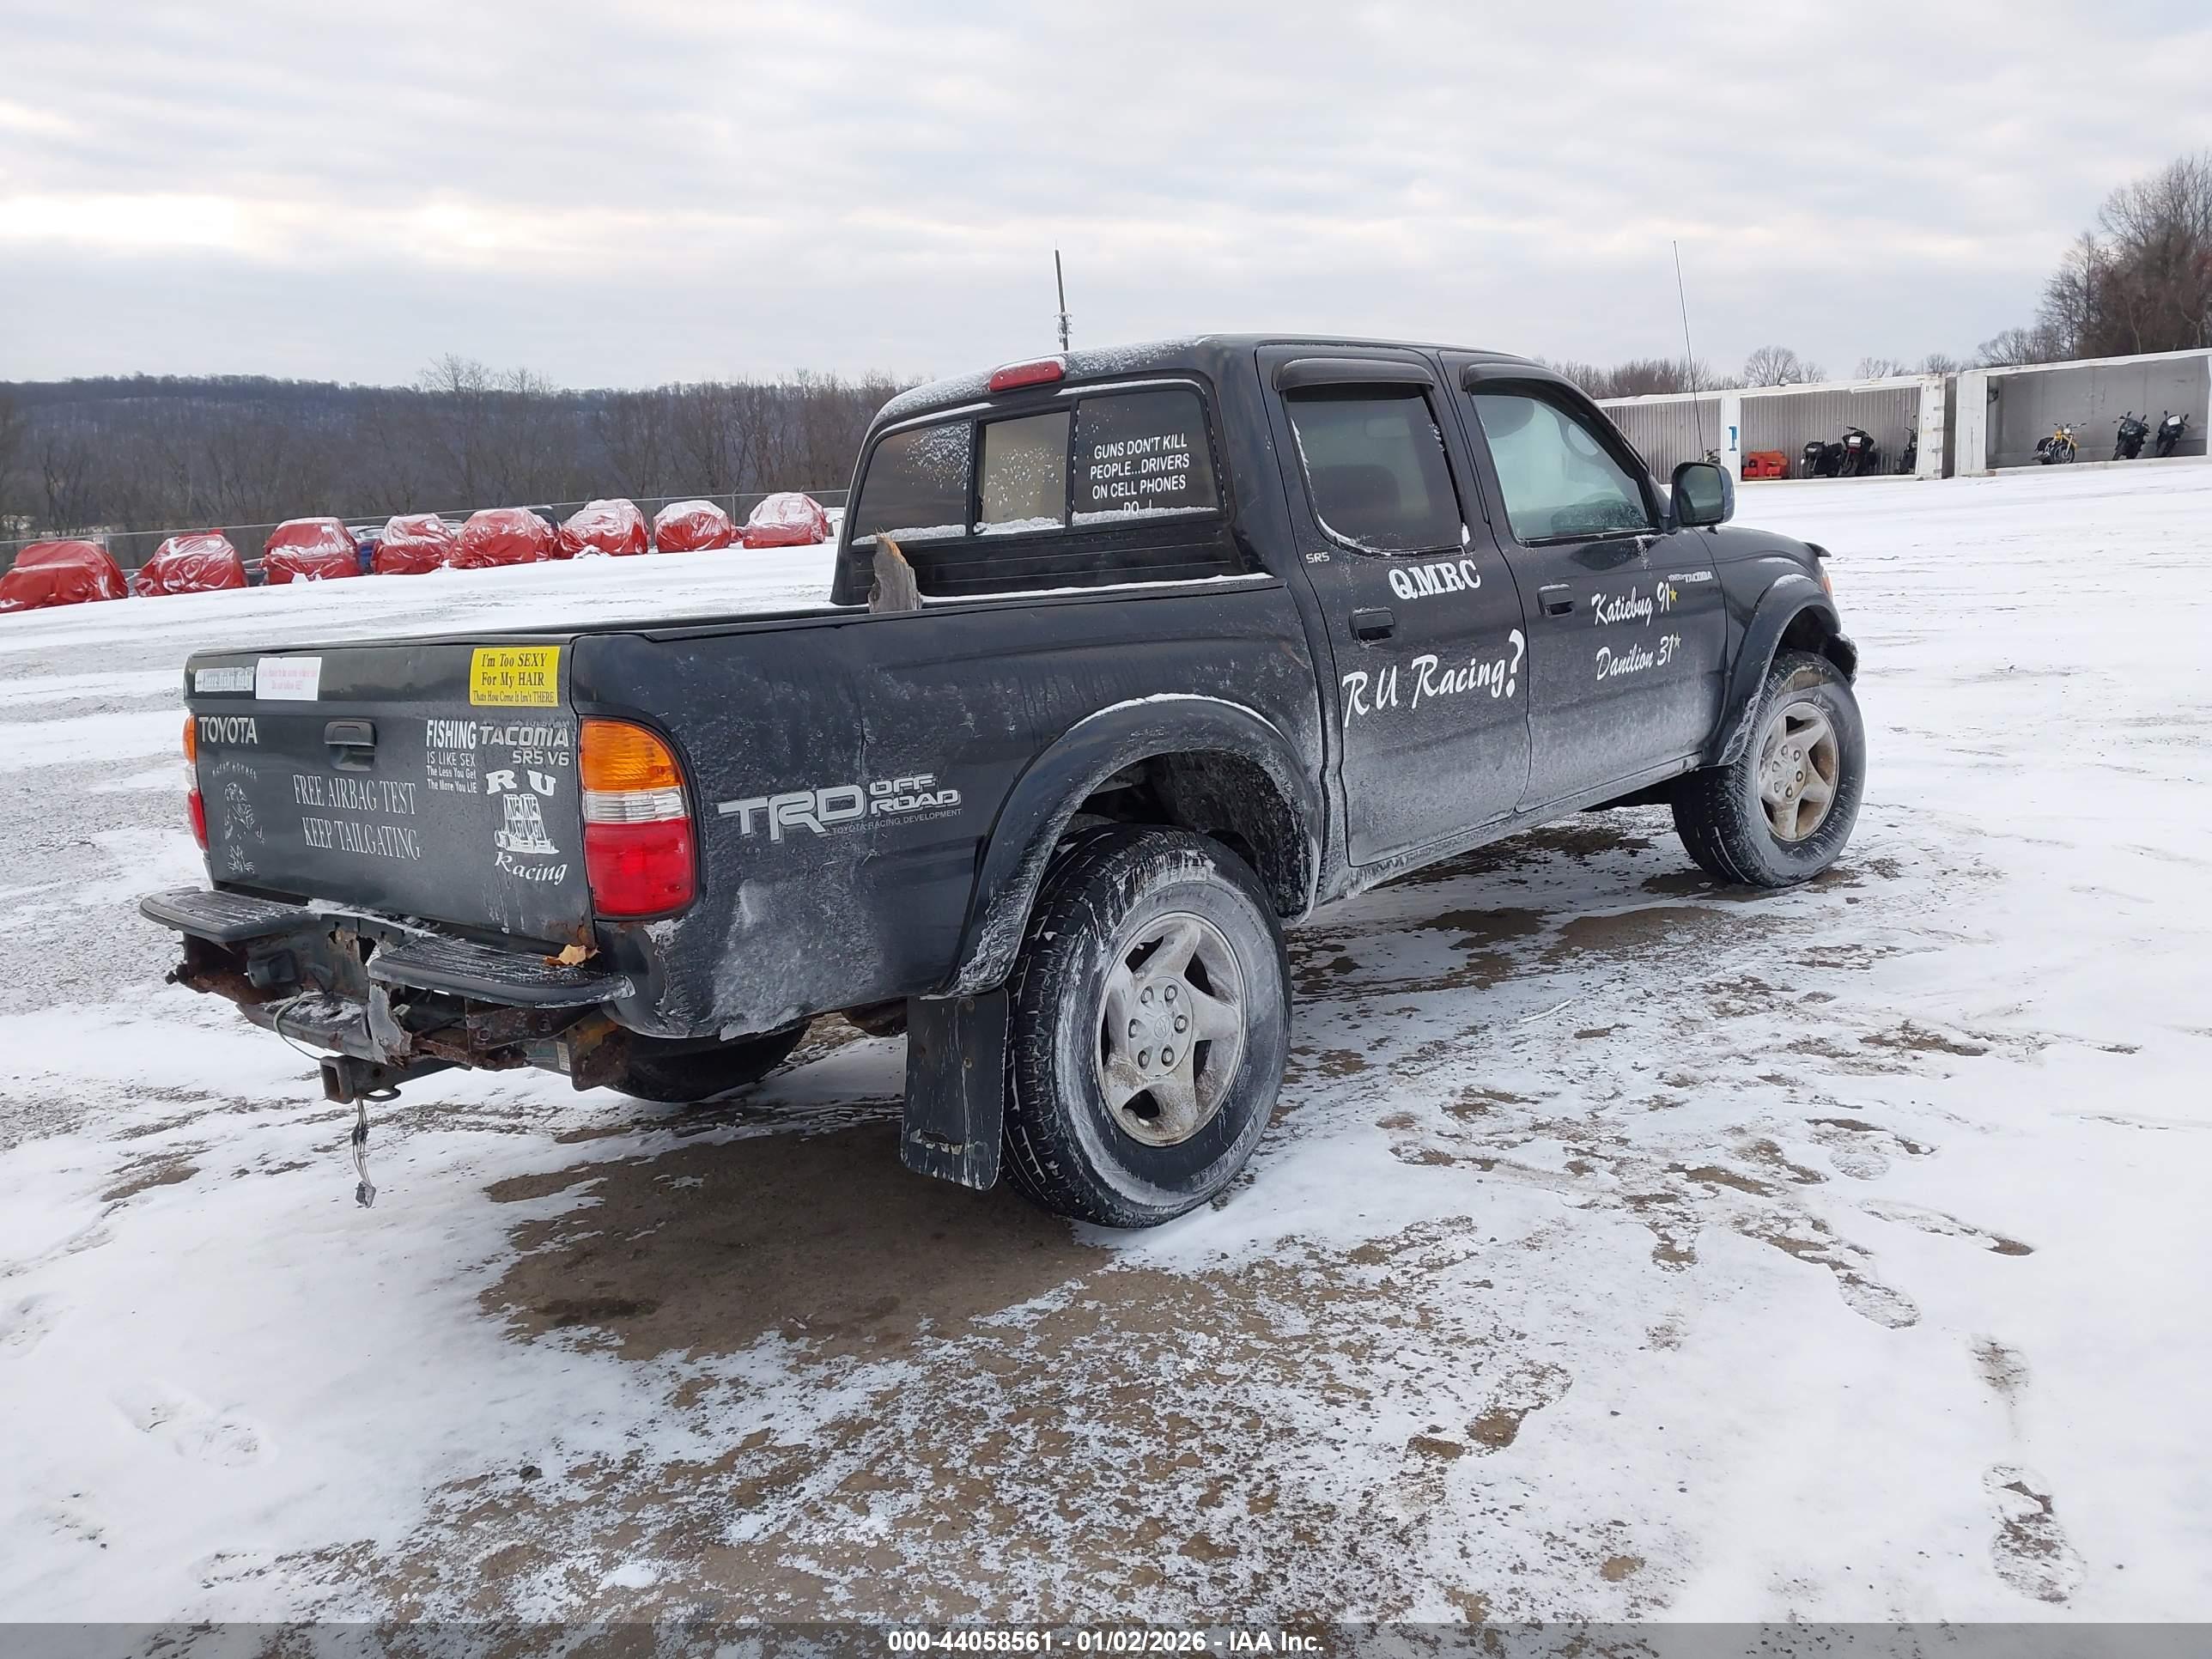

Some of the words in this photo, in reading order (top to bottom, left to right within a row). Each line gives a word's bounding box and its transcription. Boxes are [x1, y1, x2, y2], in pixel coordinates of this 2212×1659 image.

[1094, 441, 1125, 459] GUNS
[1127, 436, 1161, 455] DON'T
[1163, 432, 1188, 451] KILL
[1092, 483, 1108, 500] ON
[1110, 480, 1138, 498] CELL
[1139, 474, 1187, 495] PHONES
[1389, 559, 1481, 600] QMRC
[1591, 586, 1653, 627] Katiebug
[1656, 581, 1670, 613] 91
[482, 653, 495, 667] I'm
[500, 653, 514, 667] Too
[518, 653, 548, 667] SEXY
[1656, 633, 1674, 666] 31
[481, 672, 496, 686] For
[500, 672, 514, 689] My
[518, 672, 544, 686] HAIR
[1341, 671, 1370, 728] R
[1376, 665, 1399, 710] U
[1411, 629, 1526, 709] Racing?
[532, 690, 555, 703] THERE
[198, 716, 258, 744] TOYOTA
[426, 719, 477, 750] FISHING
[478, 726, 569, 748] TACOMA
[426, 764, 438, 776] The
[439, 767, 453, 778] Less
[453, 767, 465, 780] You
[465, 769, 477, 780] Get
[427, 750, 436, 765] IS
[438, 751, 458, 767] LIKE
[459, 752, 476, 768] SEX
[547, 751, 569, 767] V6
[292, 774, 325, 807] FREE
[327, 776, 378, 811] AIRBAG
[379, 781, 416, 816] TEST
[427, 778, 439, 791] The
[440, 780, 454, 792] More
[455, 781, 466, 793] You
[466, 782, 478, 794] LIE
[485, 769, 517, 795] R
[527, 769, 556, 797] U
[869, 774, 937, 796] OFF
[718, 785, 866, 843] TRD
[870, 789, 963, 817] ROAD
[868, 816, 902, 831] RACING
[902, 809, 963, 825] DEVELOPMENT
[301, 817, 333, 850] KEEP
[333, 820, 421, 861] TAILGATING
[494, 851, 568, 886] Racing
